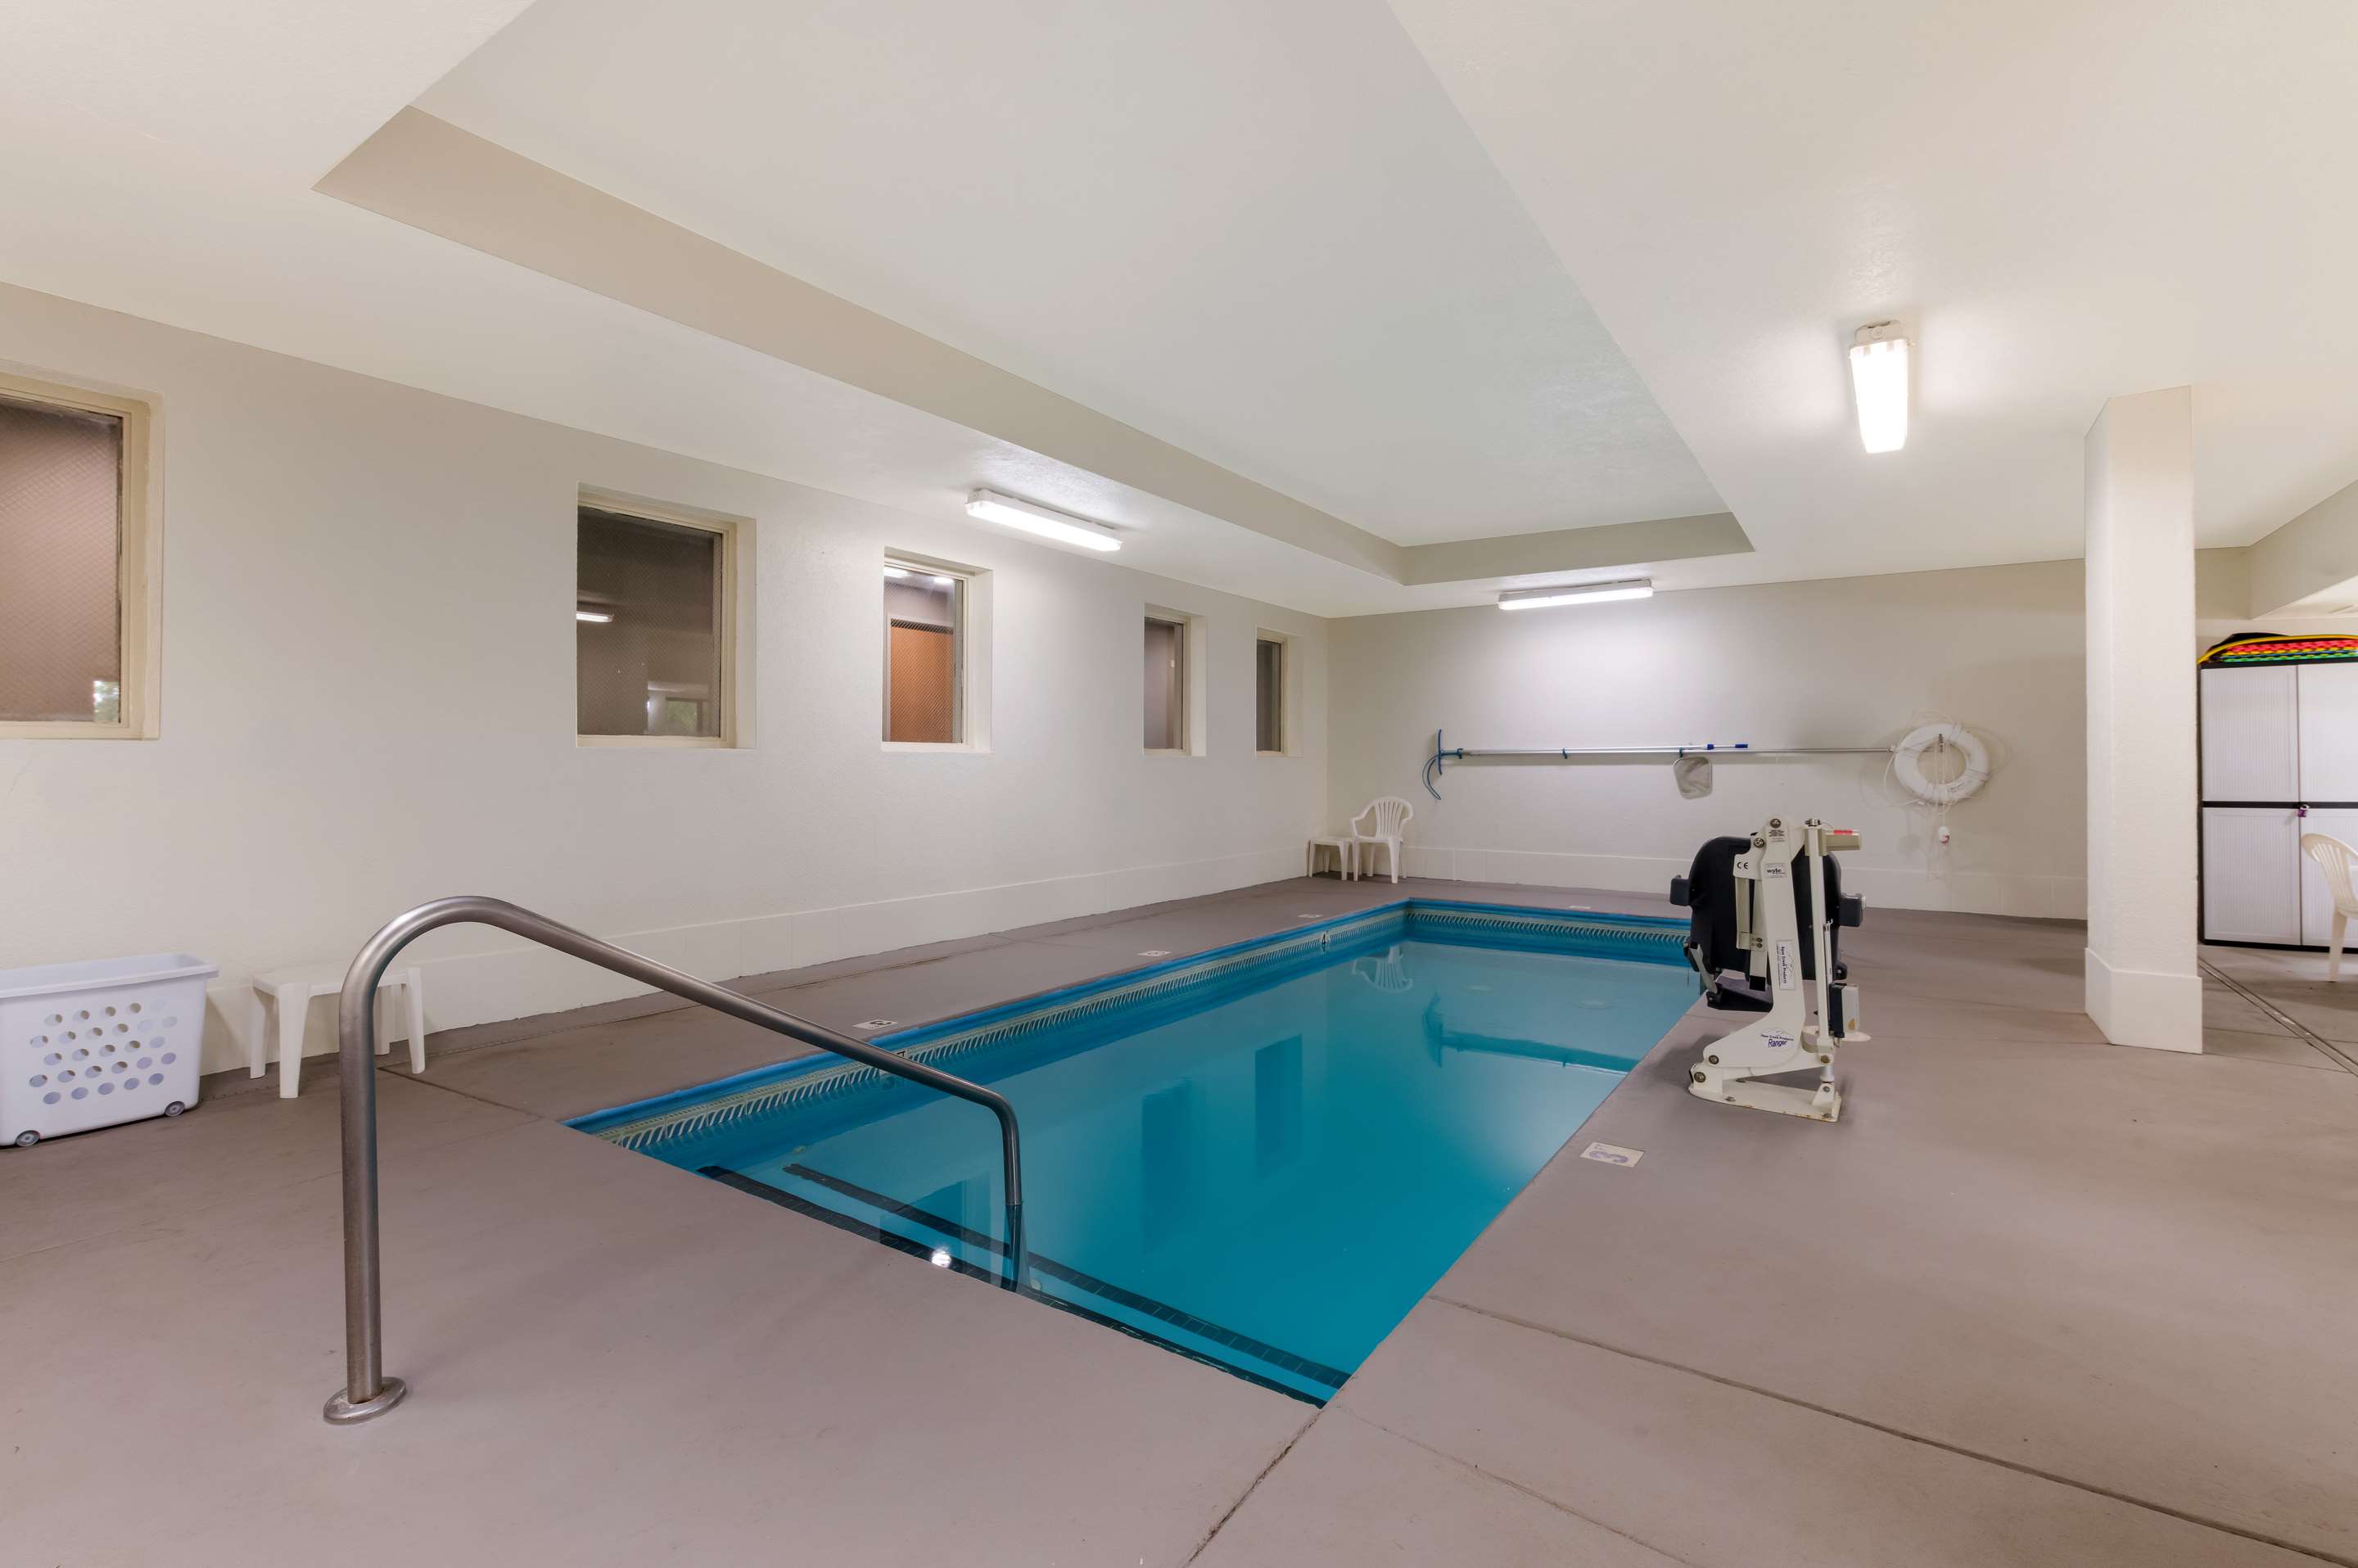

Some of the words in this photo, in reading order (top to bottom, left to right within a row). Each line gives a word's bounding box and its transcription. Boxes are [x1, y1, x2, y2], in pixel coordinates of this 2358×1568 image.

[1737, 861, 1749, 870] CE
[1768, 1038, 1787, 1047] Ranger
[1589, 1150, 1628, 1164] 3
